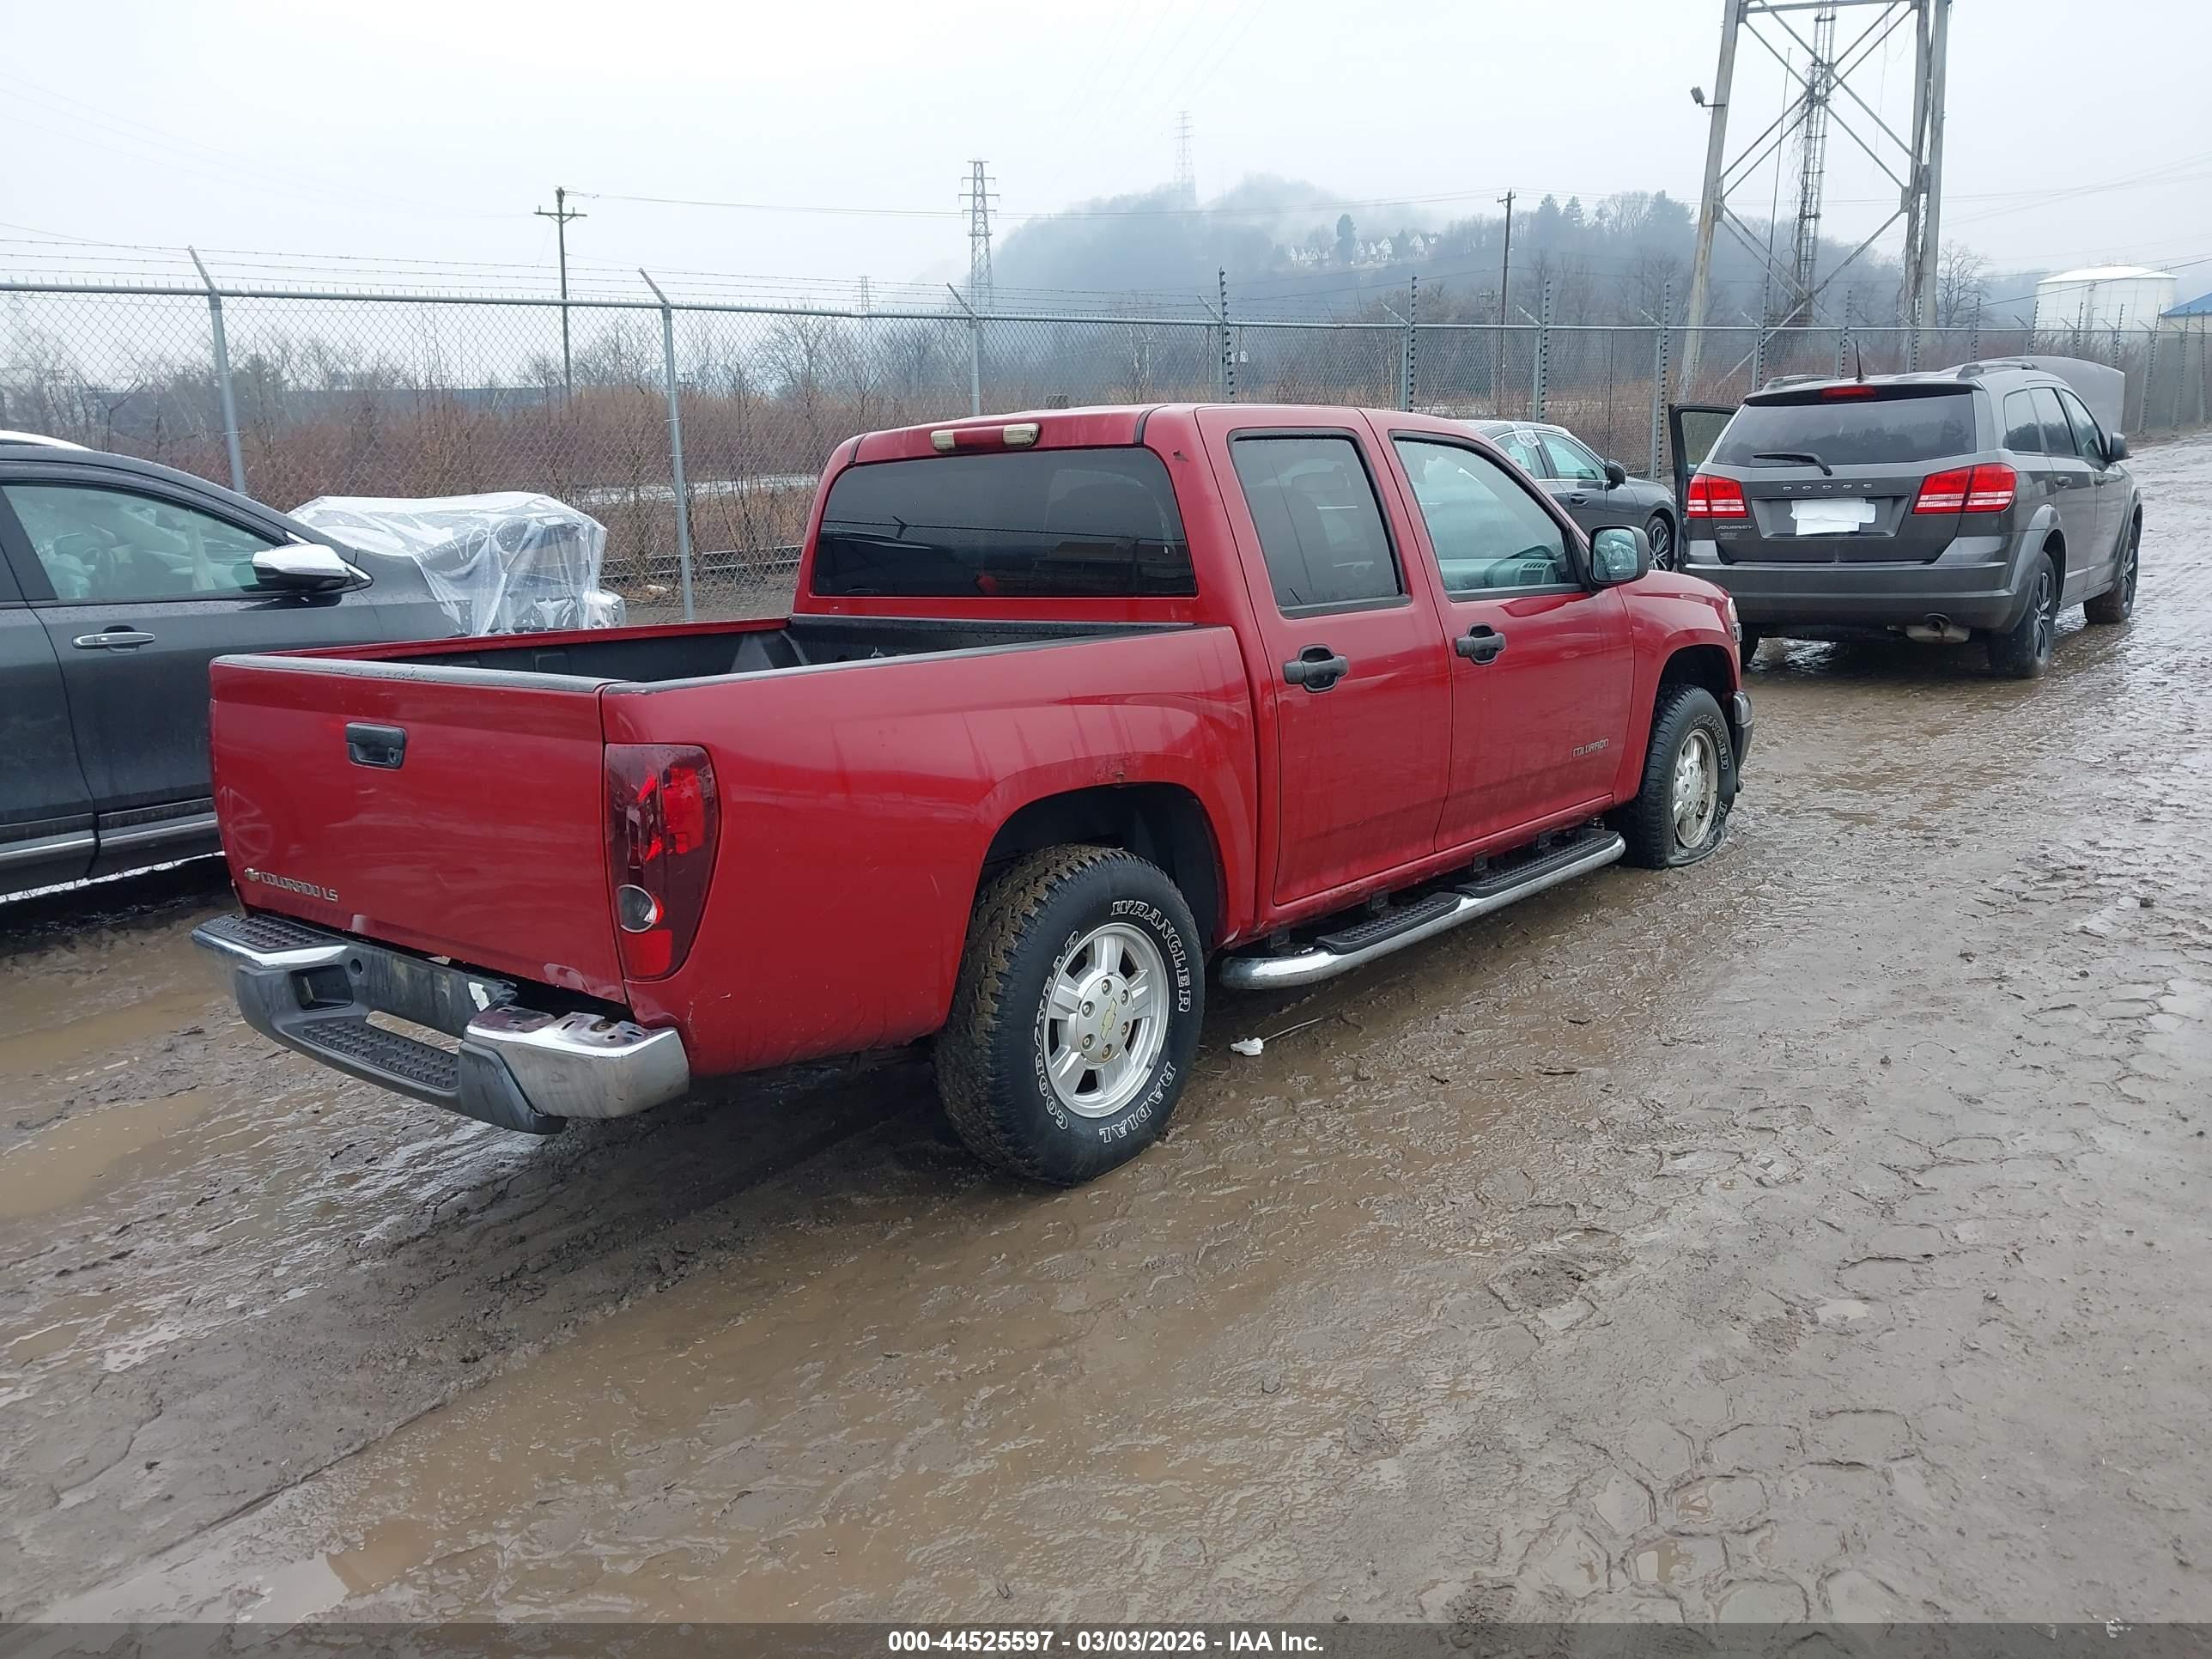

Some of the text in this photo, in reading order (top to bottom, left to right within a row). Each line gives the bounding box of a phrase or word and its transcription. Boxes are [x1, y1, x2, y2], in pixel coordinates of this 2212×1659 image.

[1782, 483, 1874, 492] DODGE
[259, 871, 339, 902] COLORADO LS
[1109, 899, 1192, 1013] WRANGLER
[1098, 1060, 1177, 1144] RADIAL
